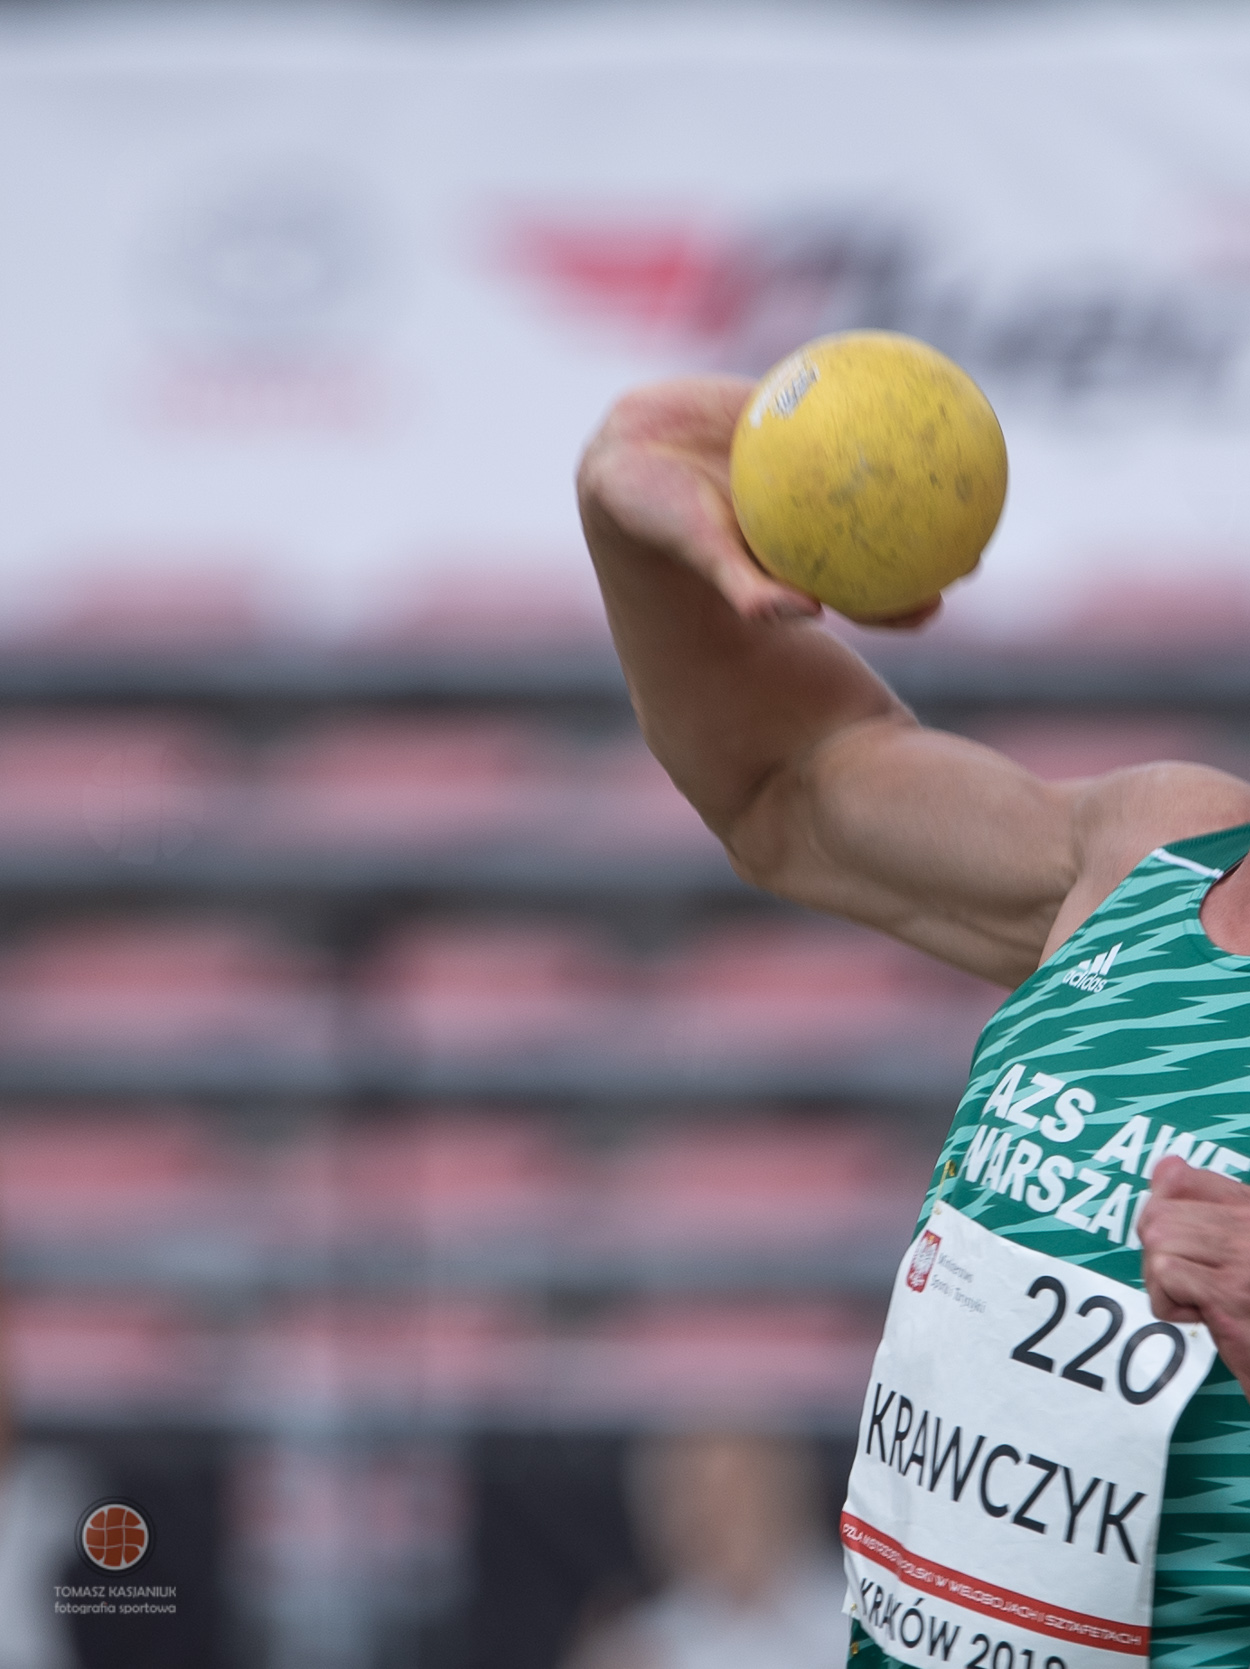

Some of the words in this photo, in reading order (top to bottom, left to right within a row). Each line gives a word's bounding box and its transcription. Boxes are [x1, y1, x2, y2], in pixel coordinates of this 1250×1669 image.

[1062, 968, 1107, 993] adidas
[982, 1063, 1096, 1142] AZS
[1011, 1275, 1186, 1405] 220
[866, 1382, 1147, 1565] KRAWCZYK
[860, 1577, 961, 1662] KRAKÓW
[1044, 1614, 1141, 1645] SZTAFETACH
